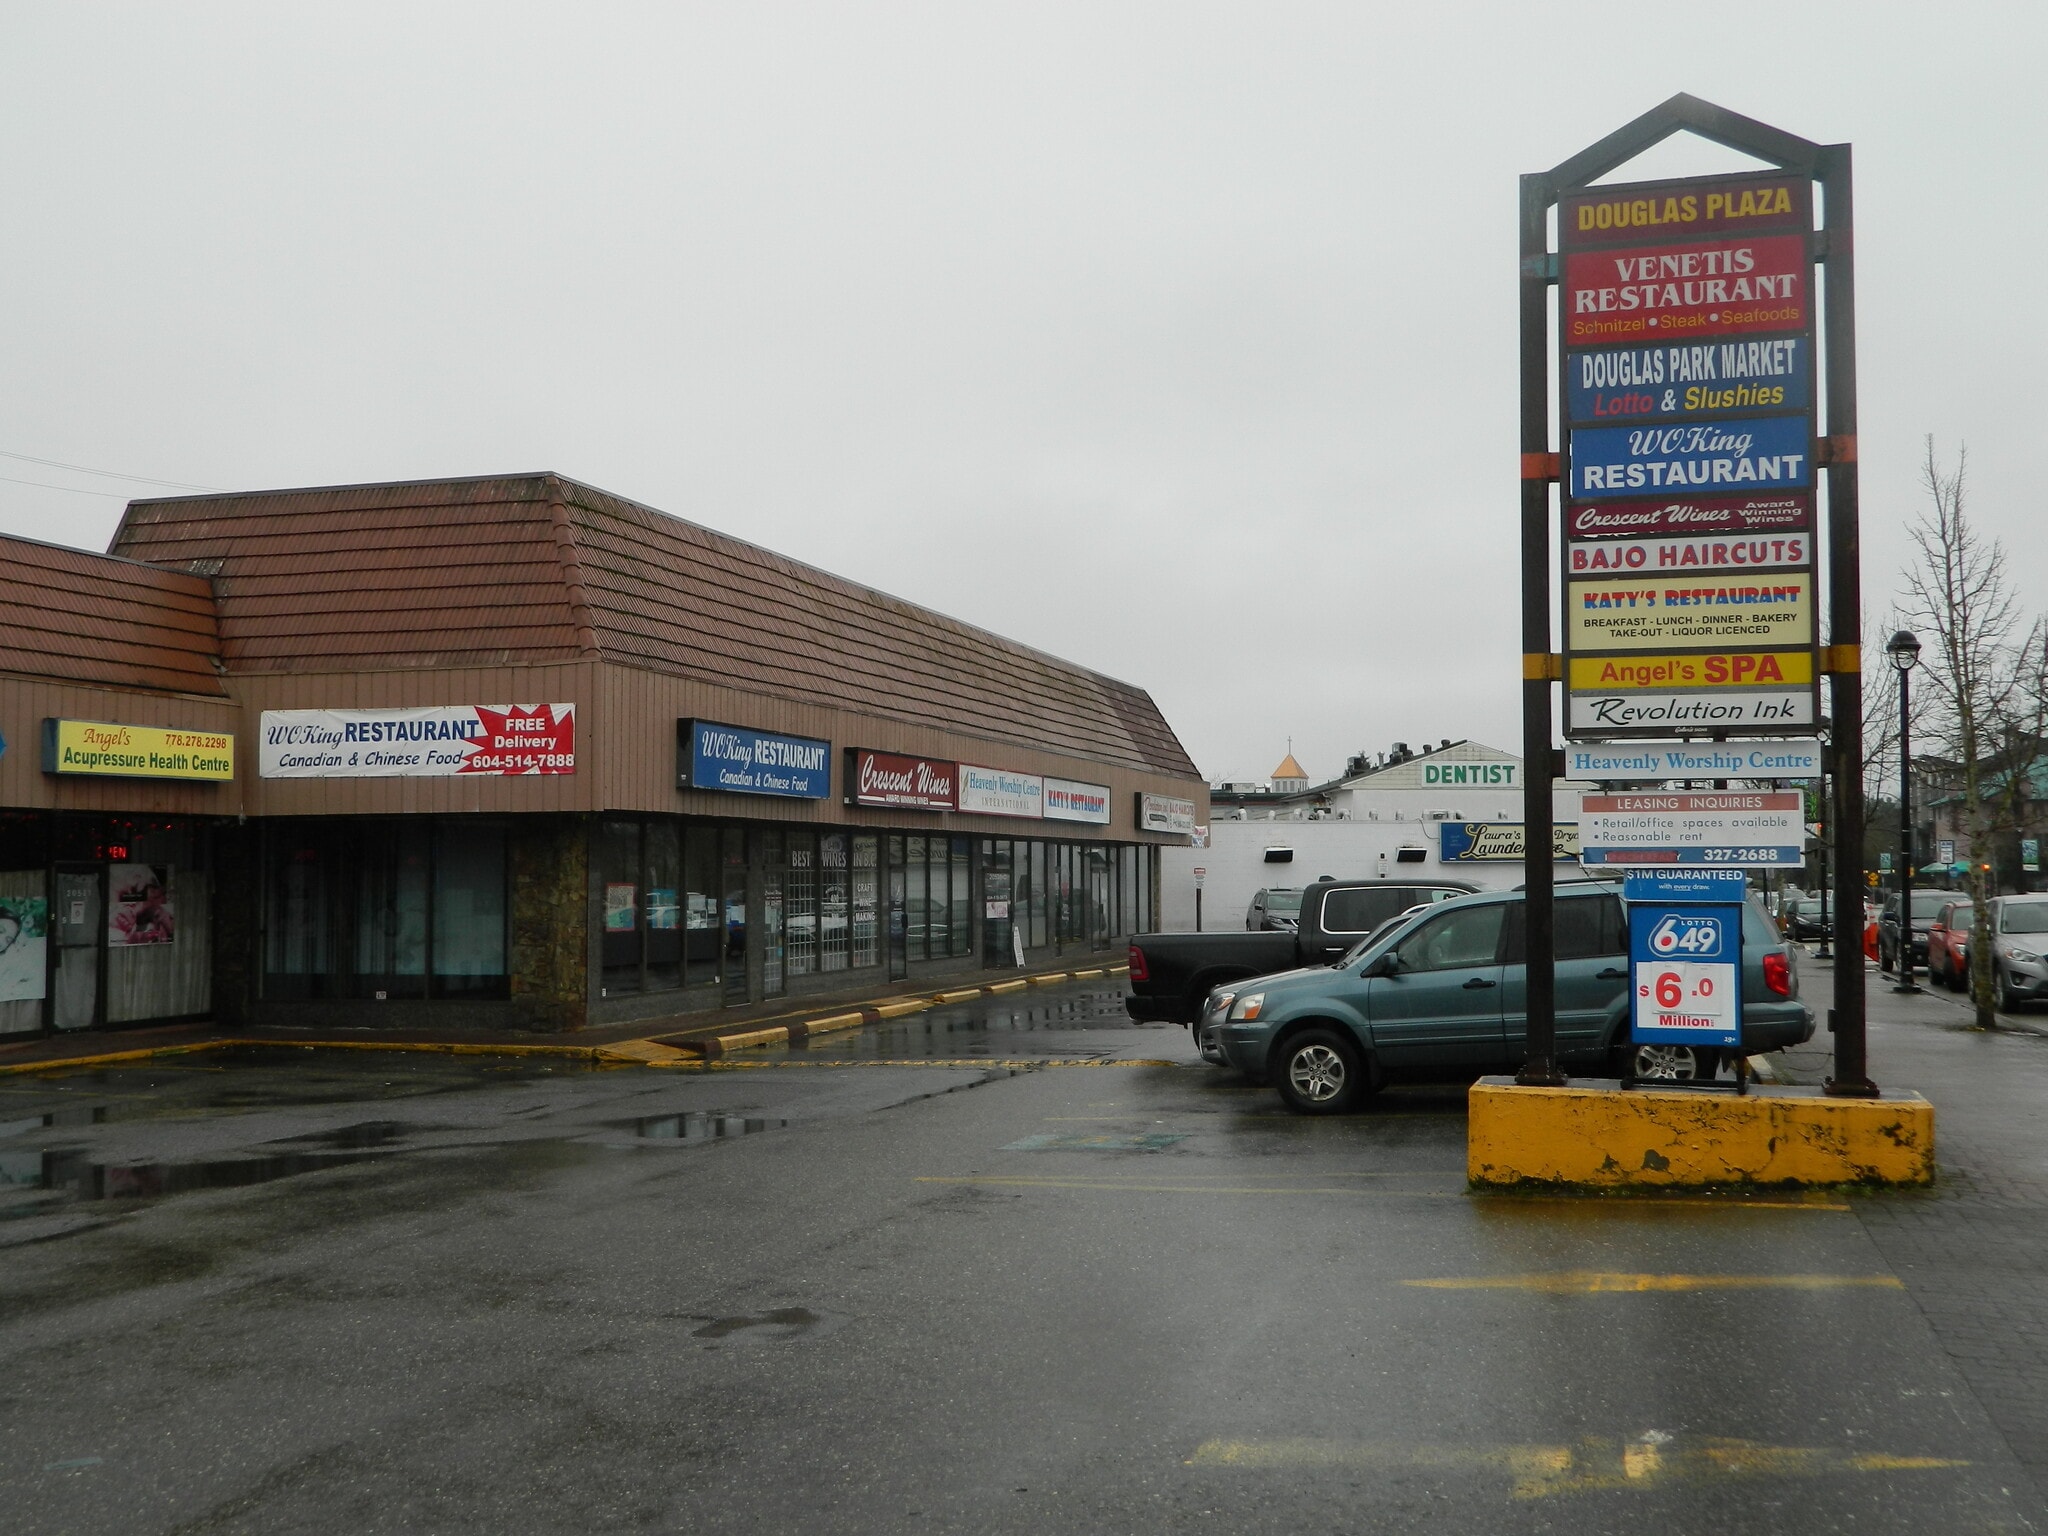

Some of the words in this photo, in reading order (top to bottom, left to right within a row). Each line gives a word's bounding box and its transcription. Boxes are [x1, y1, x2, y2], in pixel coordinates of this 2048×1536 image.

[1578, 195, 1698, 231] DOUGLAS
[1706, 187, 1792, 220] PLAZA
[1614, 249, 1755, 282] VENETIS
[1575, 273, 1798, 314] RESTAURANT
[1573, 318, 1645, 335] Schnitzel
[1661, 312, 1707, 329] Steak
[1722, 306, 1799, 324] Seafoods
[1582, 349, 1664, 389] DOUGLAS
[1670, 345, 1716, 383] PARK
[1722, 339, 1796, 379] MARKET
[1594, 393, 1654, 416] Lotto
[1661, 388, 1677, 412] &
[1684, 383, 1784, 410] Slushies
[1584, 454, 1804, 490] RESTAURANT
[1738, 508, 1802, 517] Winning
[1745, 500, 1795, 509] Award
[1575, 508, 1664, 530] Crescent
[1665, 504, 1731, 523] Wines
[1747, 516, 1794, 524] Wines
[1573, 546, 1647, 570] BAJO
[1659, 539, 1803, 567] HAIRCUTS
[1583, 590, 1657, 610] KATY'S
[1665, 586, 1801, 607] RESTAURANT
[1584, 617, 1647, 628] BREAKFAST
[1656, 616, 1693, 626] LUNCH
[1702, 615, 1743, 625] DINNER
[1752, 613, 1798, 623] BAKERY
[1610, 628, 1662, 638] TAKE-OUT
[1672, 626, 1713, 637] LIQUOR
[1716, 625, 1770, 635] LICENCED
[1600, 660, 1695, 686] Angel's
[1704, 655, 1784, 683] SPA
[1590, 698, 1743, 726] Revolution
[1753, 698, 1795, 719] Ink
[345, 719, 479, 743] RESTAURANT
[506, 718, 545, 732] FREE
[83, 727, 131, 751] Angel's
[165, 734, 227, 749] 778.278.2298
[494, 735, 557, 750] Delivery
[64, 747, 145, 769] Acupressure
[149, 752, 188, 770] Health
[192, 754, 230, 772] Centre
[279, 752, 342, 767] Canadian
[348, 752, 359, 766] &
[365, 751, 420, 766] Chinese
[426, 750, 464, 765] Food
[472, 754, 575, 768] 604-514-7888
[754, 739, 825, 771] RESTAURANT
[1575, 753, 1660, 772] Heavenly
[1666, 752, 1743, 771] Worship
[1749, 752, 1813, 768] Centre
[719, 768, 753, 787] Canadian
[755, 773, 761, 788] &
[763, 772, 790, 789] Chinese
[791, 776, 809, 791] Food
[861, 754, 913, 793] Crescent
[917, 762, 951, 795] Wines
[1425, 765, 1515, 784] DENTIST
[969, 772, 998, 794] Heavenly
[1000, 776, 1021, 797] Worship
[1023, 780, 1040, 796] Centre
[981, 797, 1030, 809] INTERNATIONAL
[1071, 794, 1105, 813] RESTAURANT
[1617, 798, 1679, 810] LEASING
[1690, 797, 1763, 809] INQUIRIES
[1602, 818, 1674, 828] Retail/office
[1683, 818, 1723, 830] spaces
[1732, 816, 1788, 827] available
[1464, 824, 1521, 850] Laura's
[1602, 831, 1671, 842] Reasonable
[1679, 832, 1703, 841] rent
[792, 850, 811, 867] BEST
[821, 851, 847, 867] WINES
[1704, 849, 1778, 861] 327-2688
[1627, 869, 1653, 881] $1M
[1657, 869, 1743, 881] GUARANTEED
[857, 883, 873, 892] CRAFT
[859, 898, 872, 907] WINE
[855, 912, 876, 921] MAKING
[1659, 1015, 1710, 1027] Million
